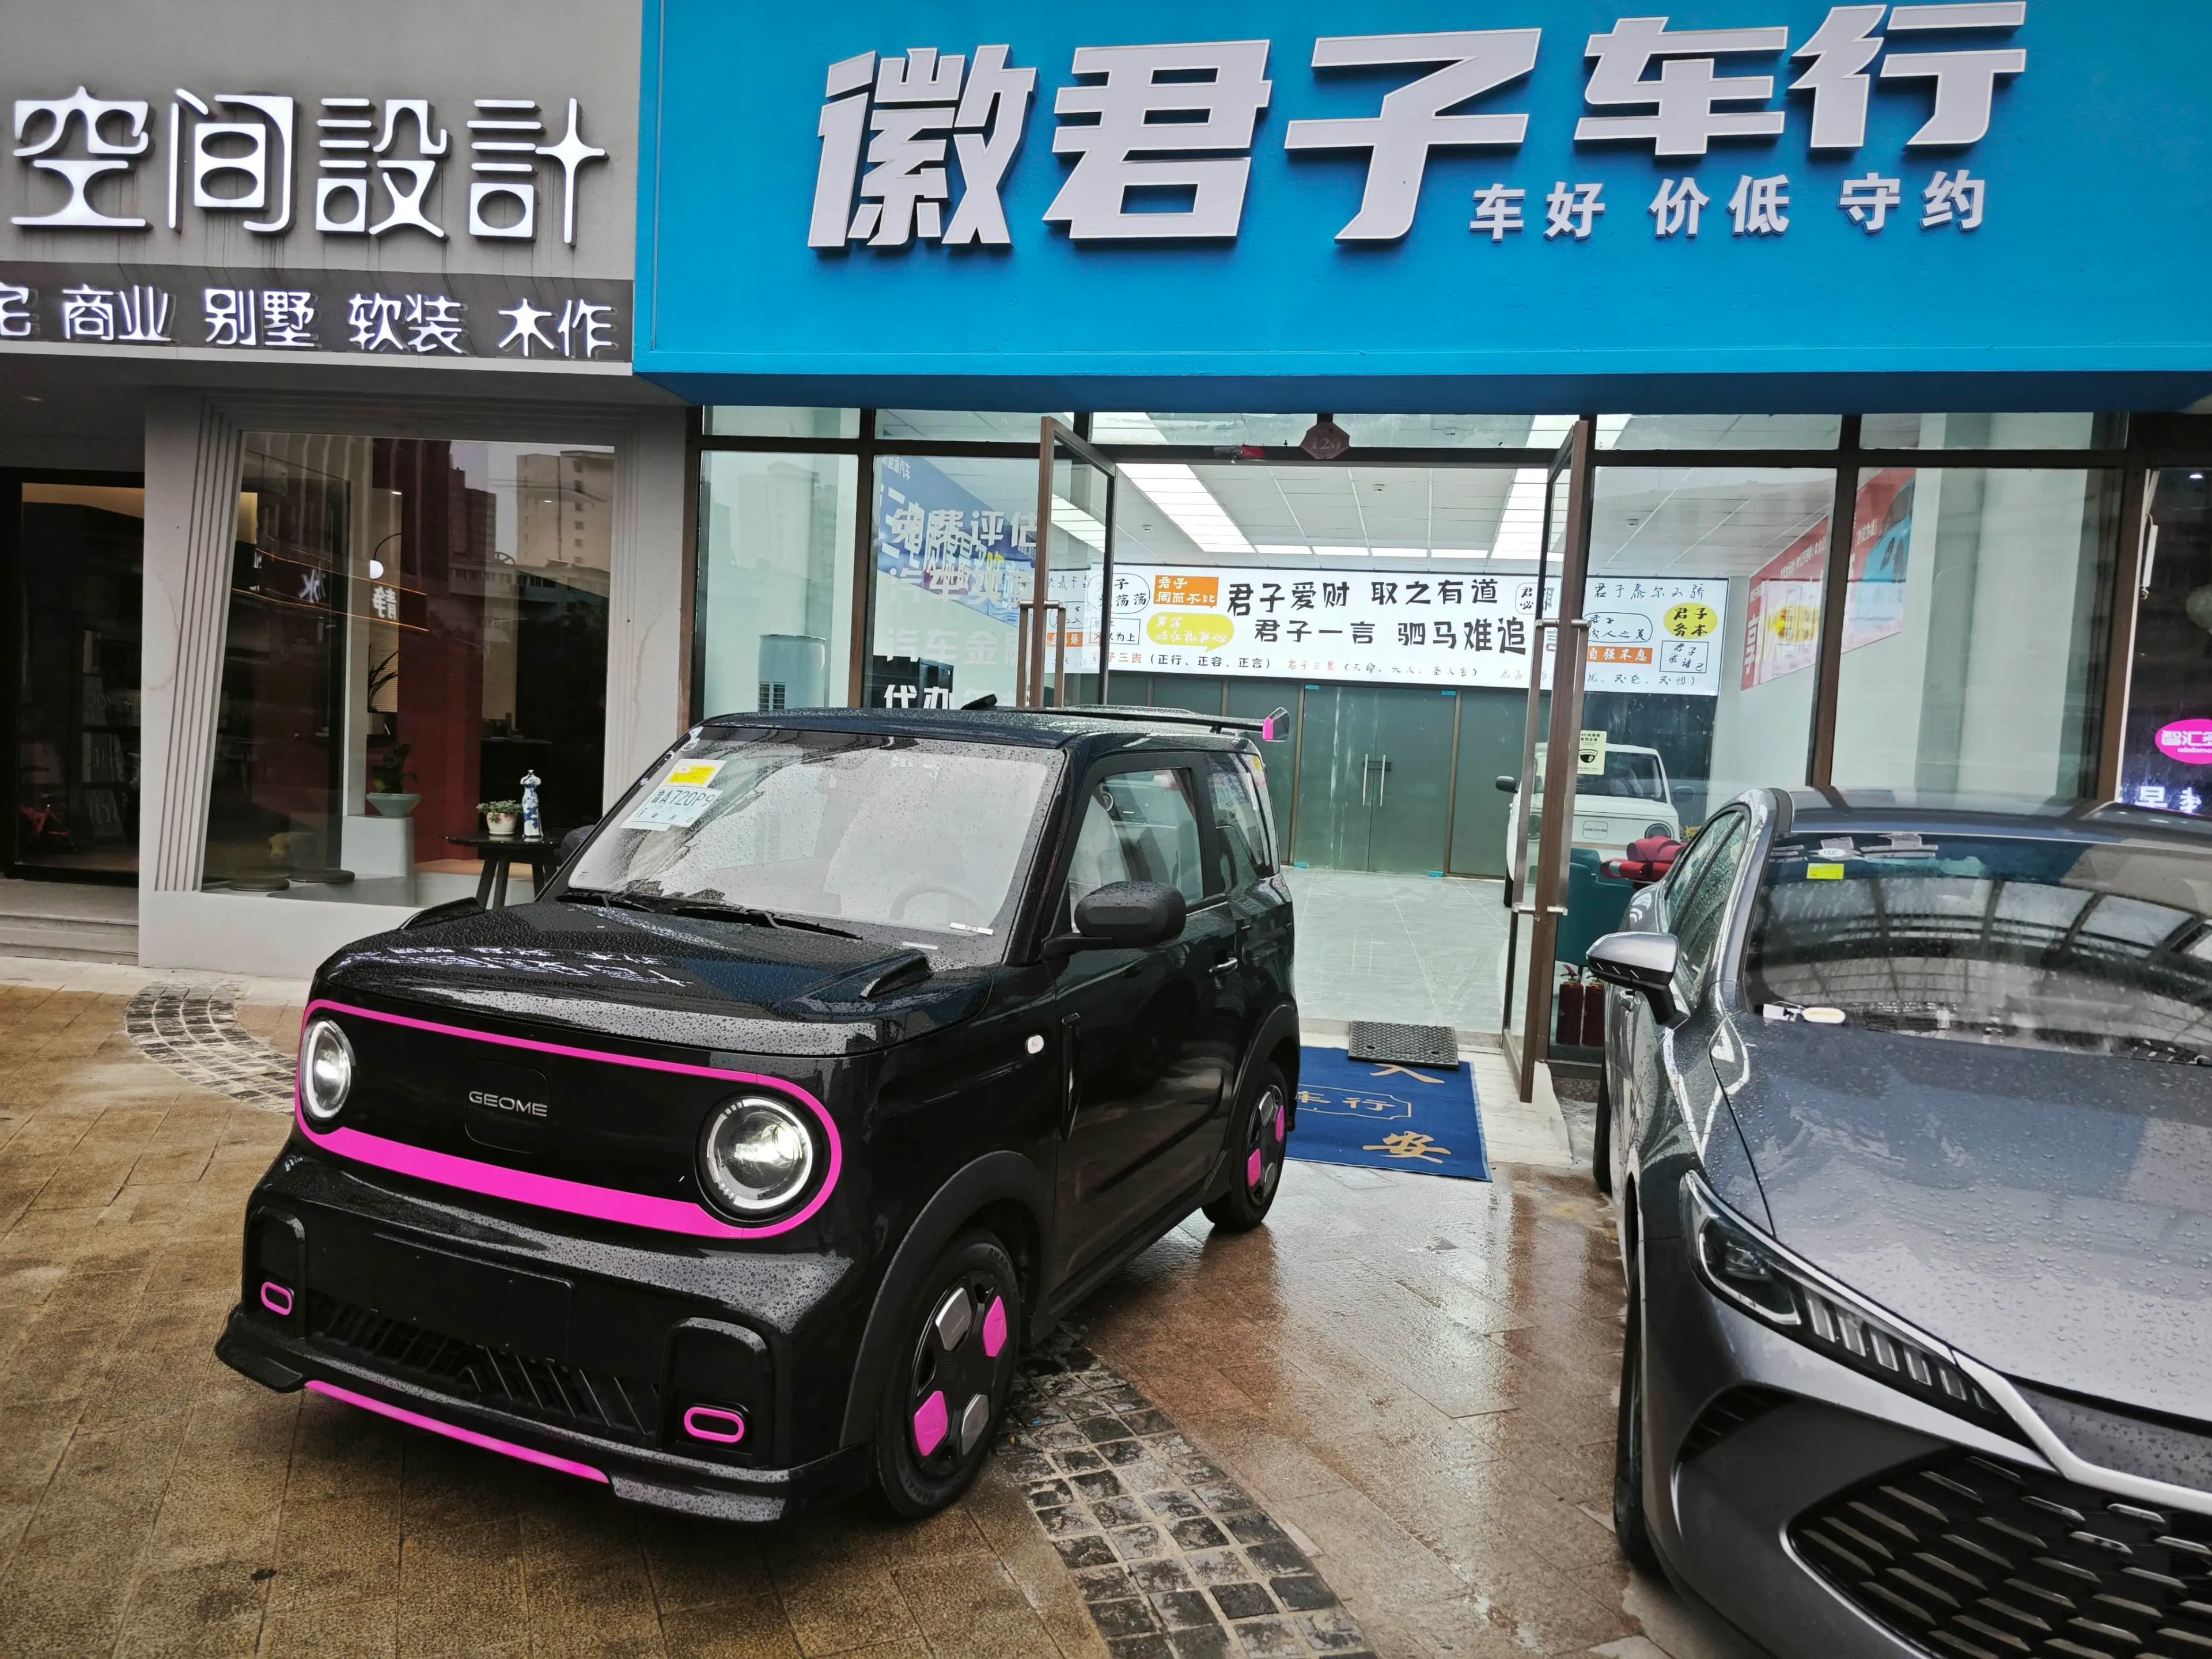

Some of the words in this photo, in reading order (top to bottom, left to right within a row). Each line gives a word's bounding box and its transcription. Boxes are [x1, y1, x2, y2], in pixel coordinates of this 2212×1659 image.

[808, 1, 2027, 248] 徽君子车行
[10, 85, 608, 245] 空间設計
[1469, 181, 1606, 242] 车好
[1648, 174, 1790, 237] 价低
[1839, 169, 1986, 232] 守约
[62, 283, 172, 342] 商业
[203, 288, 316, 347] 别墅
[347, 292, 464, 354] 软装
[498, 297, 613, 358] 木作
[1156, 592, 1215, 604] 周而不比
[1157, 576, 1188, 589] 君子
[1227, 581, 1350, 617] 君子爱财
[1371, 578, 1498, 606] 取之有道
[1109, 592, 1147, 607] 荡荡
[1673, 607, 1708, 621] 君子
[1254, 619, 1376, 645] 君子一言
[1397, 616, 1526, 656] 驷马难追
[1589, 647, 1647, 662] 自强不息
[469, 1090, 547, 1117] GEOME
